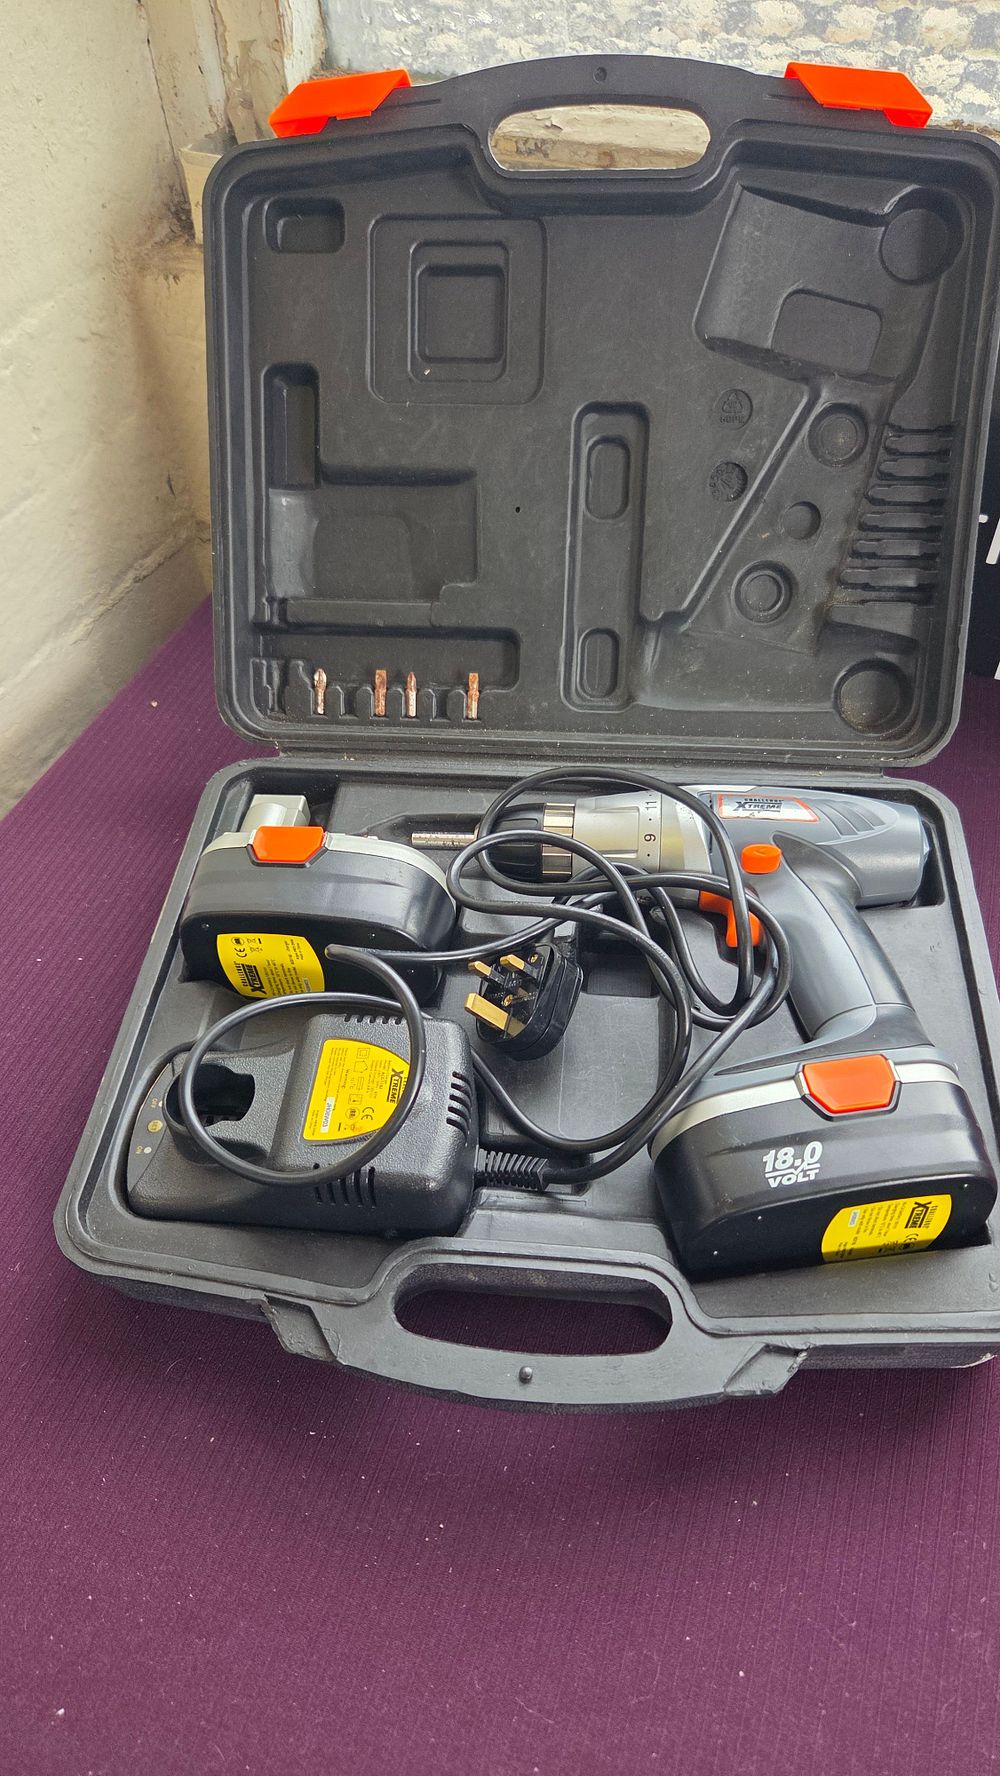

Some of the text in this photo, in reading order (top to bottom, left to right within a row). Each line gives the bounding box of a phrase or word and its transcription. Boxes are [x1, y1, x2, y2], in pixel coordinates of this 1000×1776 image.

[645, 801, 657, 811] 11
[733, 801, 782, 812] XTREME
[241, 963, 267, 994] XTREME
[386, 1068, 404, 1104] XTREME
[763, 1141, 823, 1172] 18.0
[767, 1169, 820, 1188] VOLT
[904, 1201, 932, 1229] XTREME
